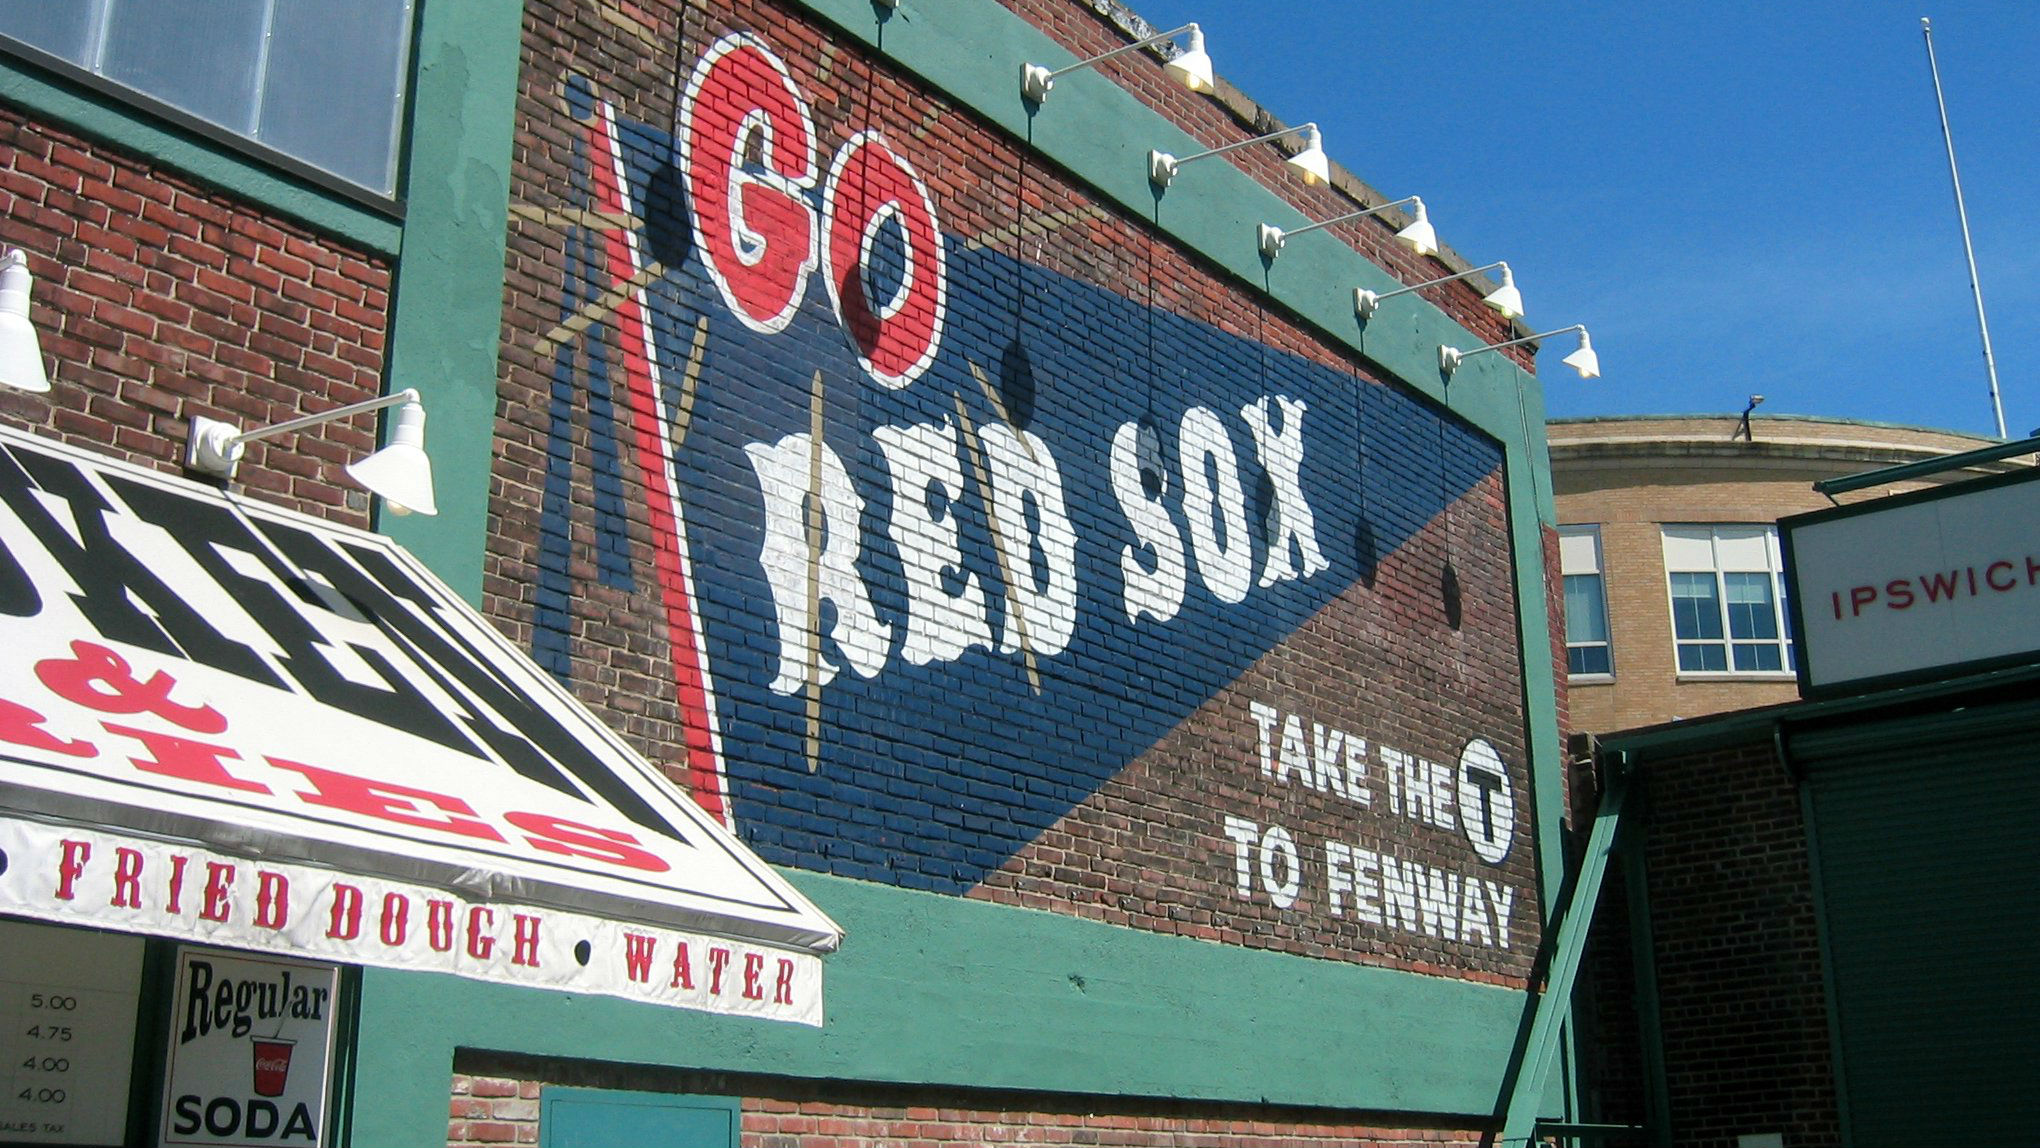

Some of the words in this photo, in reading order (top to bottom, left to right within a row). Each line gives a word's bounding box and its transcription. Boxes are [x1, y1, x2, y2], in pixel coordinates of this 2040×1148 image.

[679, 32, 946, 389] GO
[744, 414, 1078, 695] RED
[1109, 394, 1331, 626] SOX
[0, 441, 698, 849] KEN
[34, 639, 228, 734] &
[1250, 701, 1370, 807] TAKE
[1380, 746, 1455, 830] THE
[55, 839, 289, 930] FRIED
[326, 883, 542, 966] DOUGH
[624, 932, 794, 1004] WATER
[1225, 816, 1300, 908] TO
[1326, 841, 1514, 948] FENWAY
[26, 1025, 72, 1041] 4.75
[31, 993, 77, 1011] 5.00
[182, 960, 327, 1045] Regular
[18, 1088, 66, 1104] 4.00
[22, 1056, 69, 1072] 4.00
[174, 1095, 316, 1141] SODA
